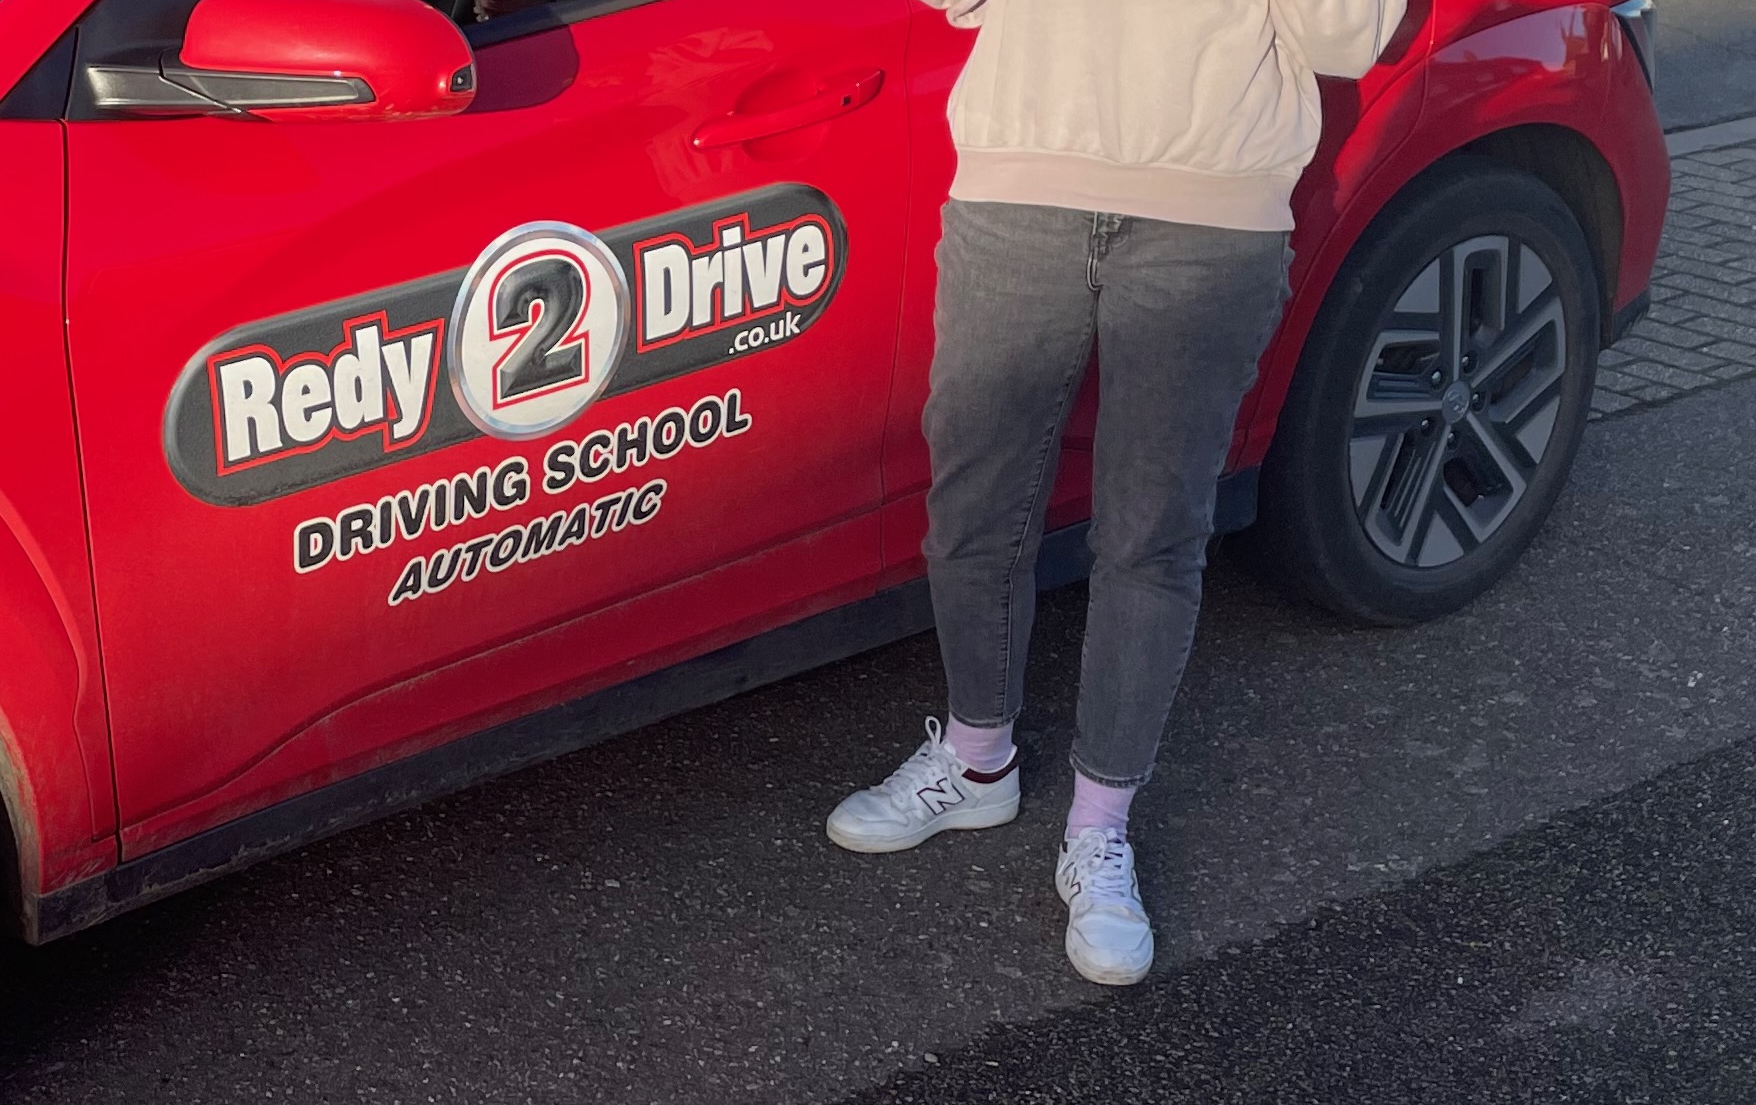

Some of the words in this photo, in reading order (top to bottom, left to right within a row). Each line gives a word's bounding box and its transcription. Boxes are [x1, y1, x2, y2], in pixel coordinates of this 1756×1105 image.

[218, 323, 437, 462] Redy
[494, 255, 590, 401] 2
[643, 221, 828, 342] Drive
[294, 456, 530, 574] DRIVING
[543, 388, 752, 495] SCHOOL
[388, 480, 667, 605] AUTOMATIC
